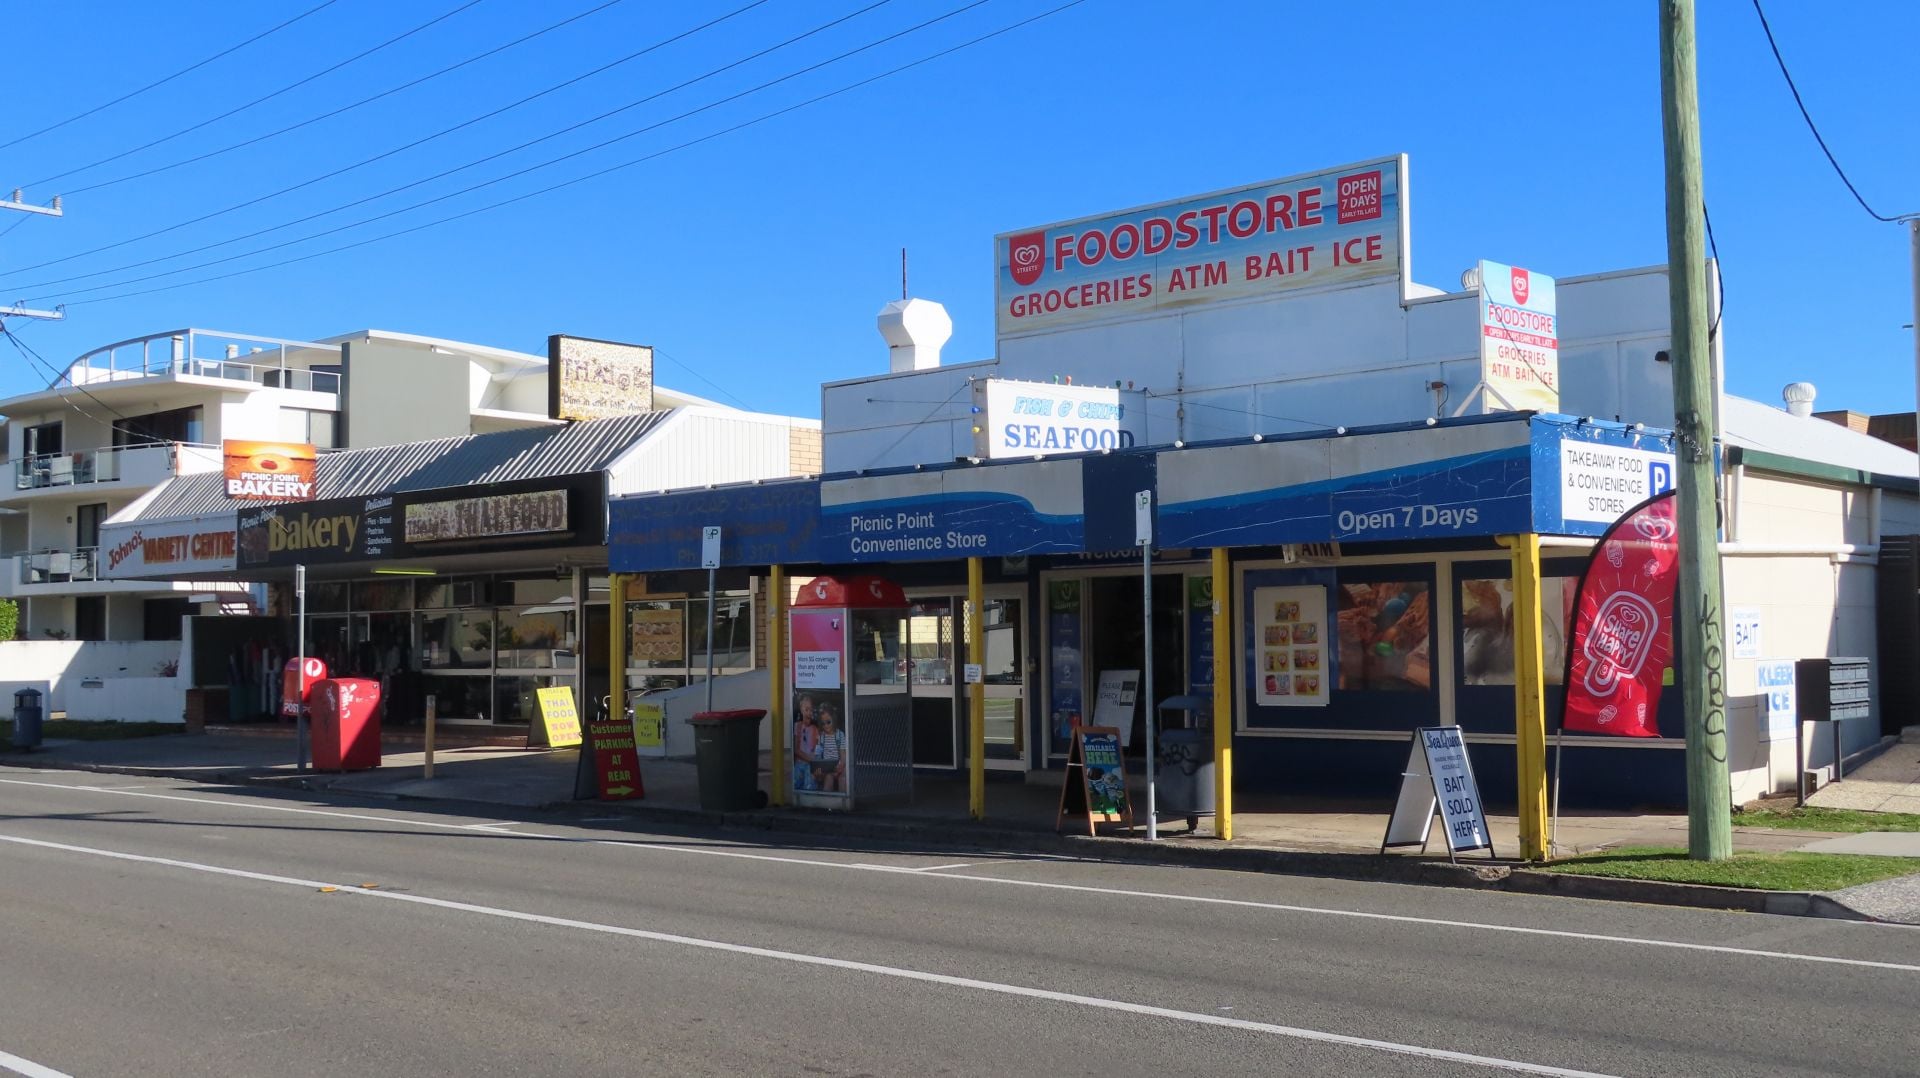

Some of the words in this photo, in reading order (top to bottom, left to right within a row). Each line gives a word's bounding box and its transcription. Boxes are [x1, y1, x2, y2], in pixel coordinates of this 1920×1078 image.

[1342, 177, 1377, 196] OPEN
[1342, 199, 1348, 210] 7
[1350, 193, 1377, 209] DAYS
[1055, 188, 1322, 271] FOODSTORE
[1009, 273, 1153, 318] GROCERIES
[1168, 261, 1228, 293] ATM
[1245, 246, 1315, 281] BAIT
[1333, 234, 1382, 267] ICE
[1016, 265, 1038, 274] STREETS
[1488, 304, 1553, 334] FOODSTORE
[1489, 328, 1503, 337] OPEN
[1497, 345, 1546, 366] GROCERIES
[1492, 363, 1511, 378] ATM
[1515, 366, 1534, 381] BAIT
[1540, 372, 1553, 386] ICE
[1013, 396, 1053, 417] FISH
[1058, 400, 1073, 418] &
[1078, 402, 1124, 421] CHIPS
[1004, 423, 1135, 451] SEAFOOD
[1567, 450, 1616, 471] TAKEAWAY
[1618, 456, 1643, 473] FOOD
[241, 472, 272, 481] PICNIC
[273, 473, 300, 482] POINT
[1568, 472, 1574, 488] &
[1577, 473, 1643, 495] CONVENIENCE
[228, 480, 312, 497] BAKERY
[508, 494, 565, 532] FOOD
[1588, 496, 1625, 514] STORES
[241, 514, 260, 530] Picnic
[851, 514, 893, 532] Picnic
[897, 511, 935, 529] Point
[1338, 510, 1395, 534] Open
[1402, 506, 1415, 527] 7
[1421, 504, 1478, 529] Days
[268, 512, 359, 553] Bakery
[108, 530, 143, 571] Johno's
[142, 535, 190, 564] VARIETY
[191, 531, 236, 561] CENTRE
[850, 534, 942, 554] Convenience
[946, 531, 987, 549] Store
[1735, 623, 1759, 645] BAIT
[815, 656, 836, 664] coverage
[1758, 663, 1794, 687] KLEER
[546, 699, 570, 708] THAI
[1764, 692, 1790, 712] ICE
[546, 709, 574, 719] FOOD
[551, 721, 575, 731] NOW
[591, 723, 632, 734] Customer
[552, 731, 580, 742] OPEN
[594, 737, 633, 750] PARKING
[611, 754, 622, 766] AT
[1086, 751, 1118, 765] HERE
[607, 770, 631, 782] REAR
[1443, 775, 1466, 793] BAIT
[1448, 798, 1473, 816] SOLD
[1453, 819, 1479, 838] HERE
